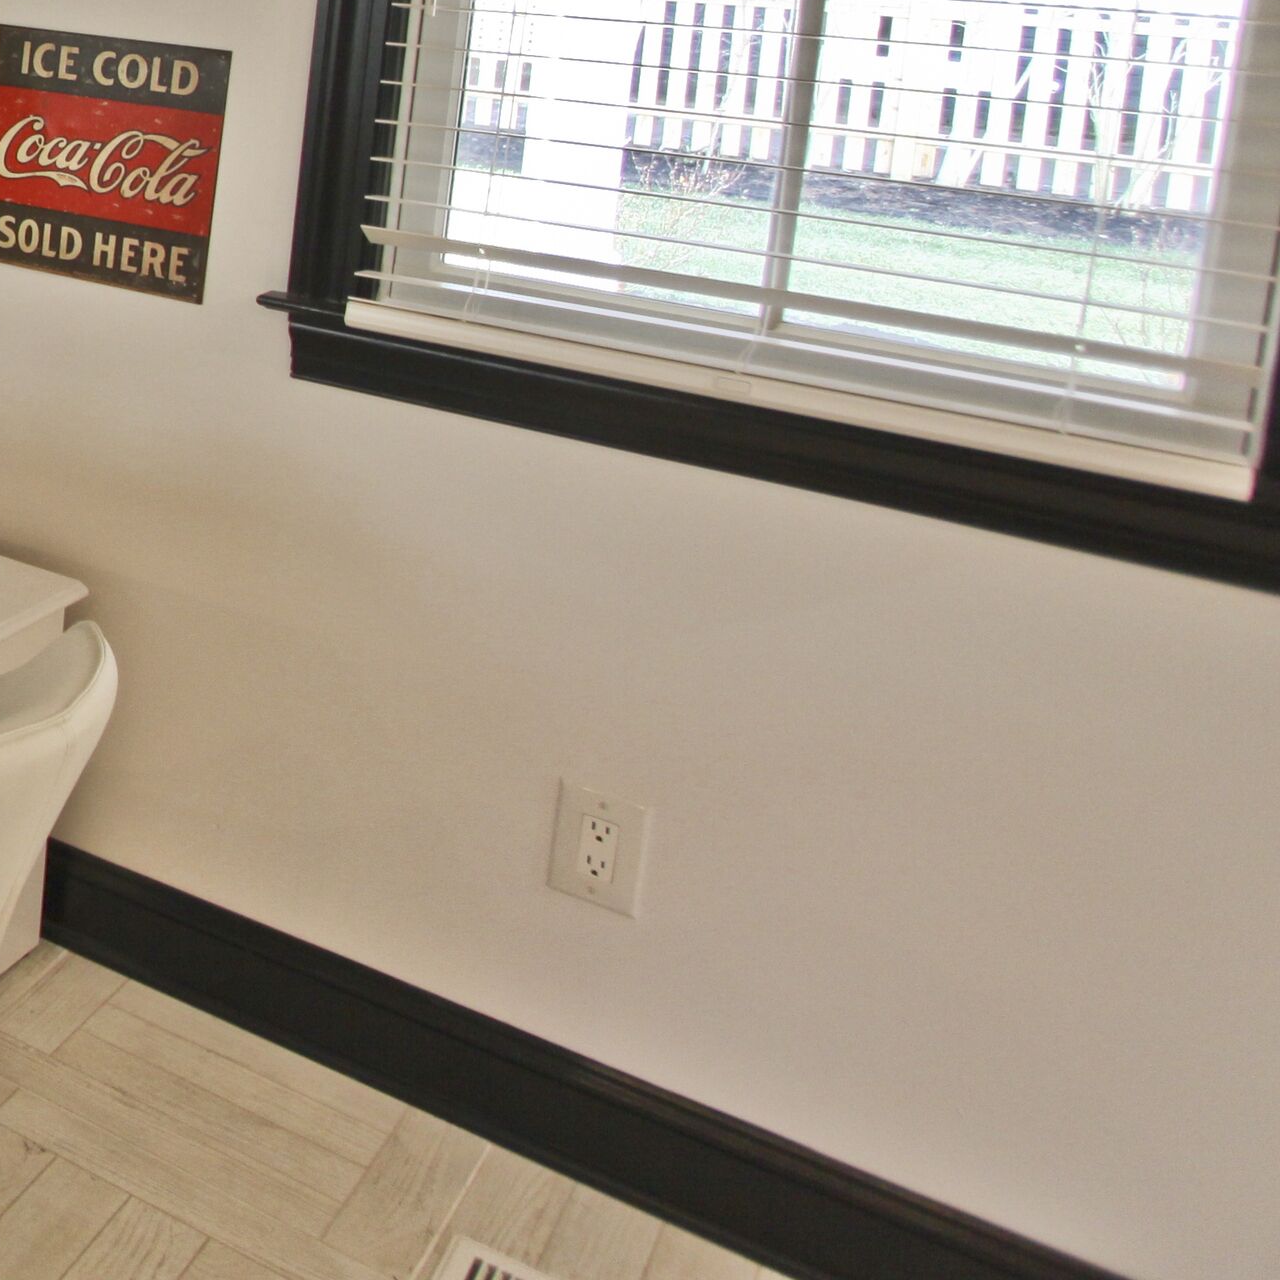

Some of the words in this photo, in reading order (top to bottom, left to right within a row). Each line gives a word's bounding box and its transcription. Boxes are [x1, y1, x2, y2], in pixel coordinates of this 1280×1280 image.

[20, 40, 80, 81] ICE
[93, 50, 200, 96] COLD
[93, 231, 191, 285] HERE
